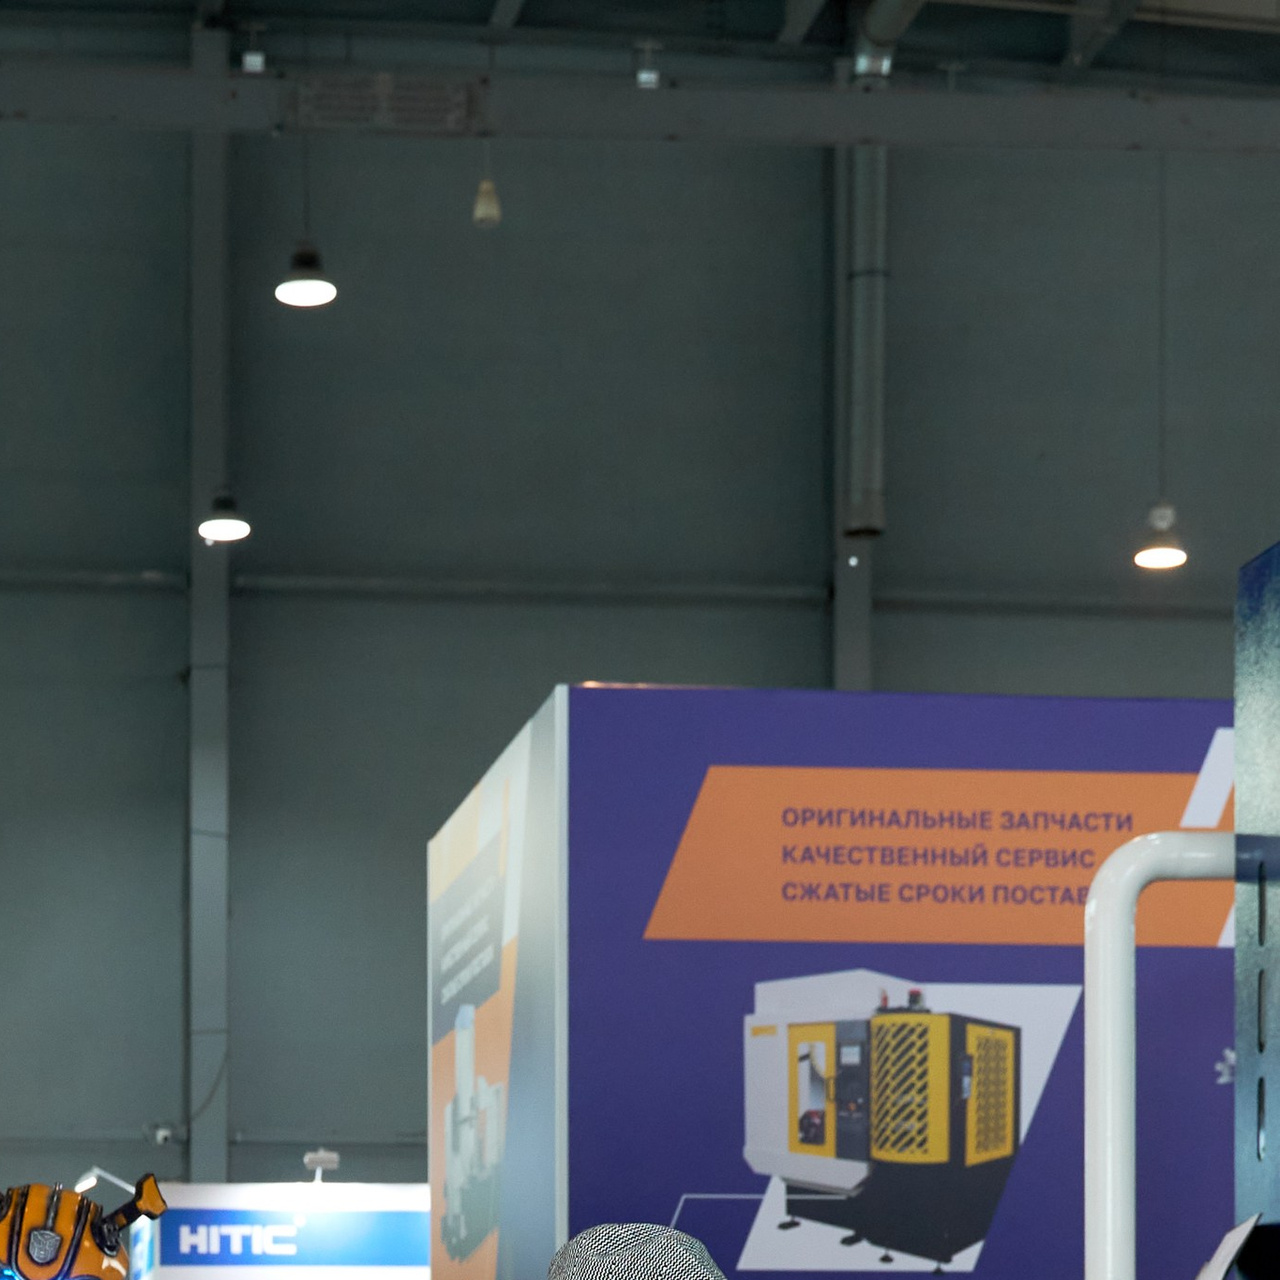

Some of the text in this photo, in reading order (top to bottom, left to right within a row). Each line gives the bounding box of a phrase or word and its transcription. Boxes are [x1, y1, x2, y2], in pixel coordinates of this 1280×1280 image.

[781, 807, 1134, 833] ОРИГИНАЛЬНЫЕ ЗАПЧАСТИ
[781, 842, 1096, 869] КАЧЕСТВЕННЫЙ СЕРВИС
[781, 881, 891, 903] СЖАТЫЕ
[898, 883, 985, 904] СРОКИ
[178, 1224, 298, 1256] HITIC
